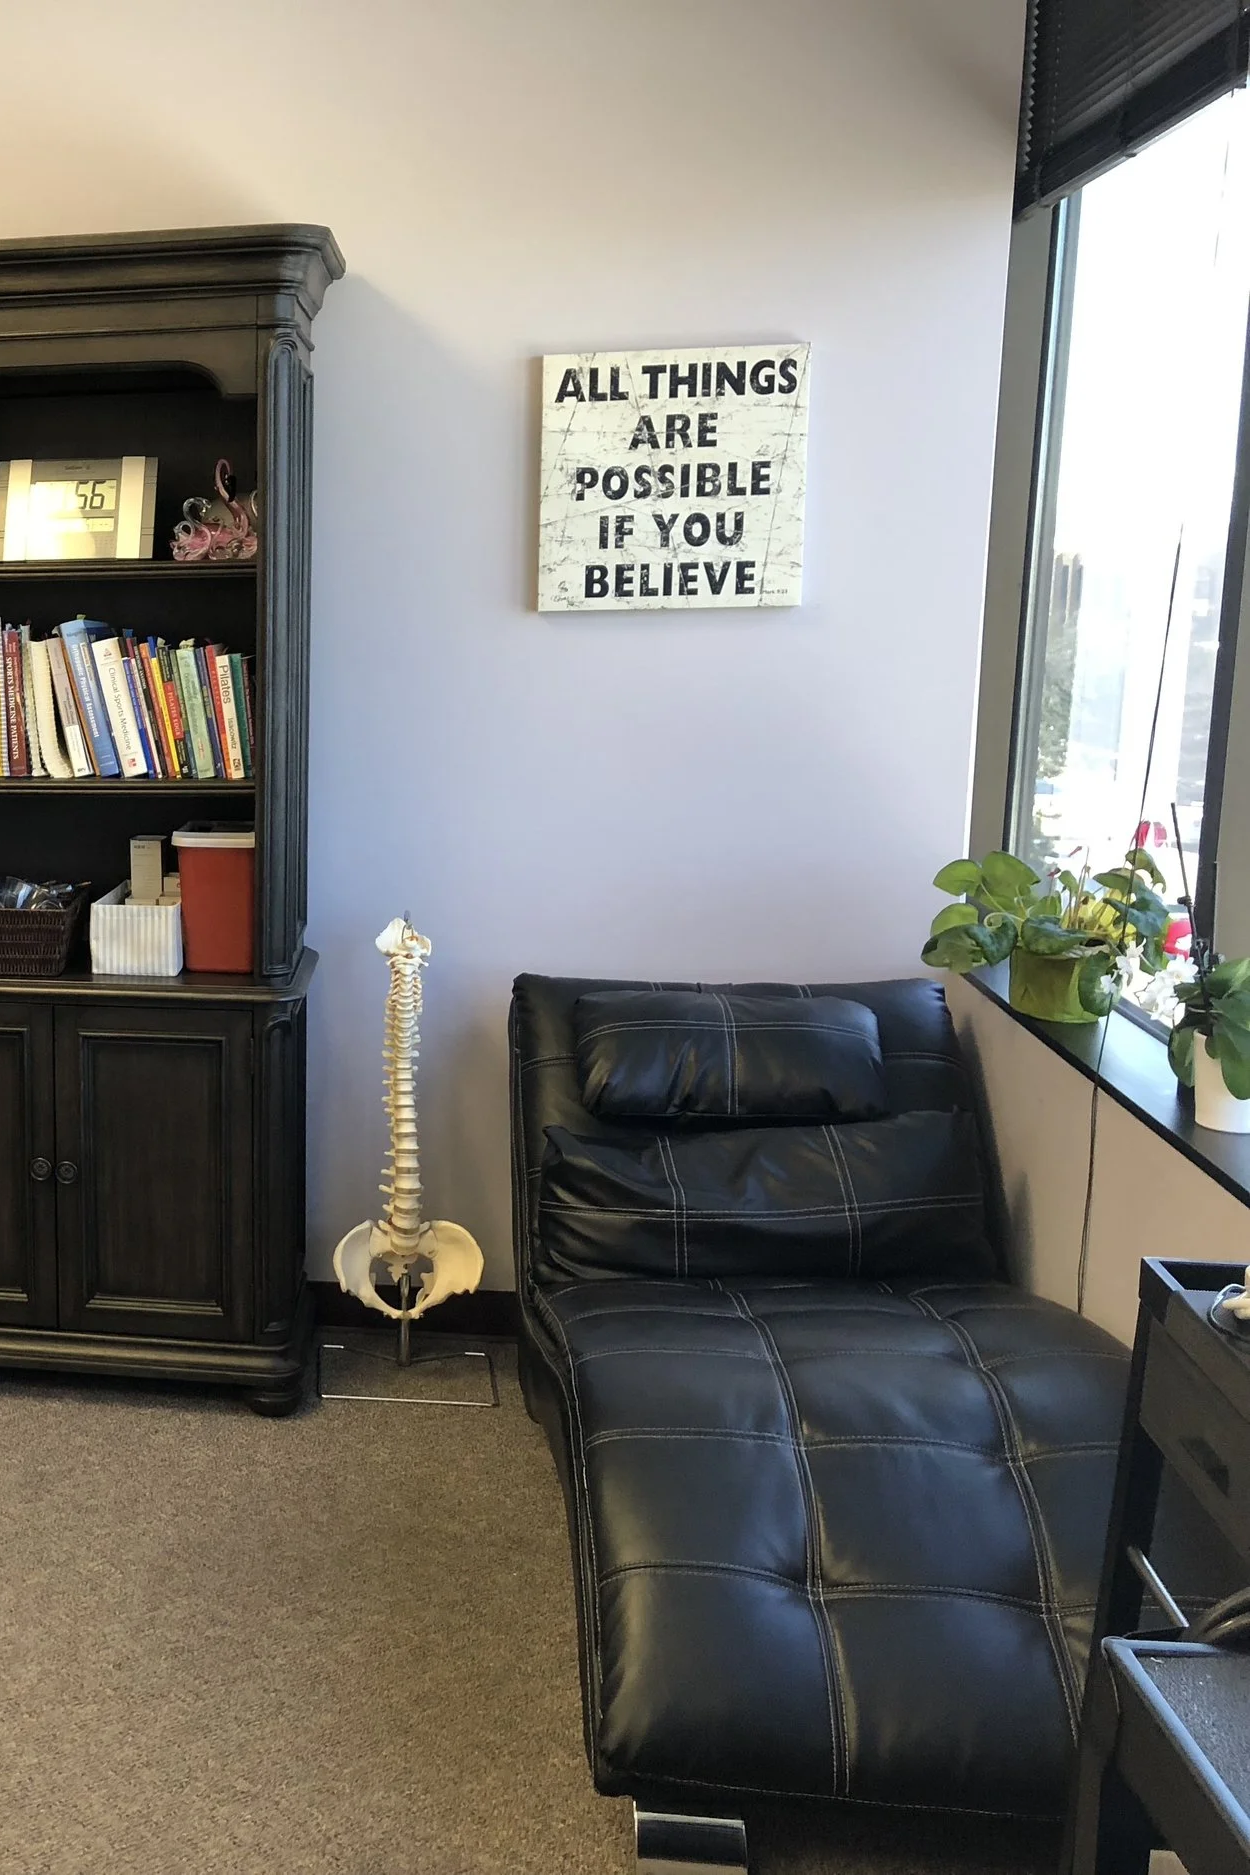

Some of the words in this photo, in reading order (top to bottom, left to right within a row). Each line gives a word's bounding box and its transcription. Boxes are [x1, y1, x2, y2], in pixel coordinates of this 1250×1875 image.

[554, 366, 629, 403] ALL
[641, 358, 798, 400] THINGS
[628, 412, 718, 450] ARE
[75, 480, 106, 510] 56
[575, 461, 772, 501] POSSIBLE
[599, 515, 635, 549] IF
[651, 511, 745, 548] YOU
[584, 560, 756, 598] BELIEVE
[8, 685, 16, 723] MEDICINE
[108, 667, 119, 694] Clinical
[114, 694, 125, 718] Sports
[120, 717, 132, 750] Medicine
[218, 664, 231, 704] Pilates
[228, 717, 237, 749] Isacowitz
[11, 724, 19, 759] PATIENTS
